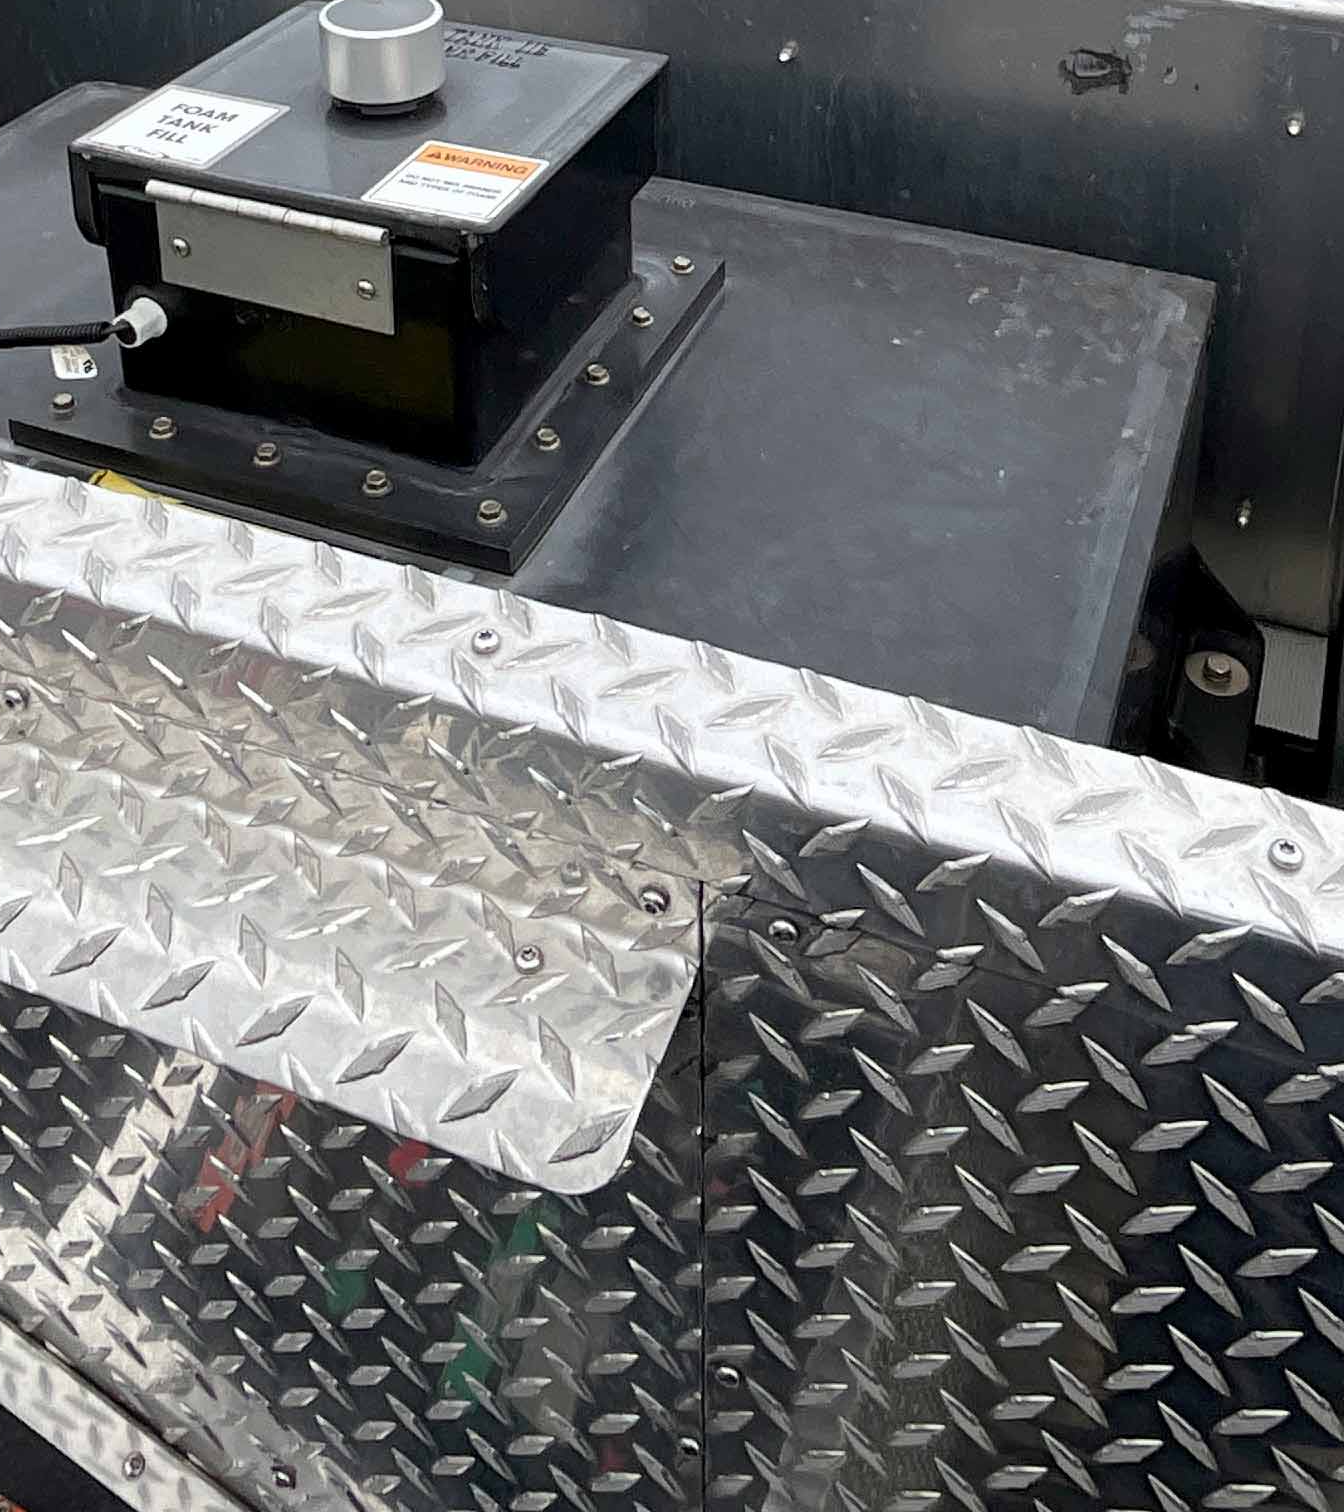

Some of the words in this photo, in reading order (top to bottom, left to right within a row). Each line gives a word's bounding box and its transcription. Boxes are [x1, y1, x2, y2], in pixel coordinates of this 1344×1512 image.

[169, 102, 239, 123] FOAM
[155, 114, 221, 134] TANK
[145, 128, 191, 145] FILL
[443, 153, 530, 176] WARNING
